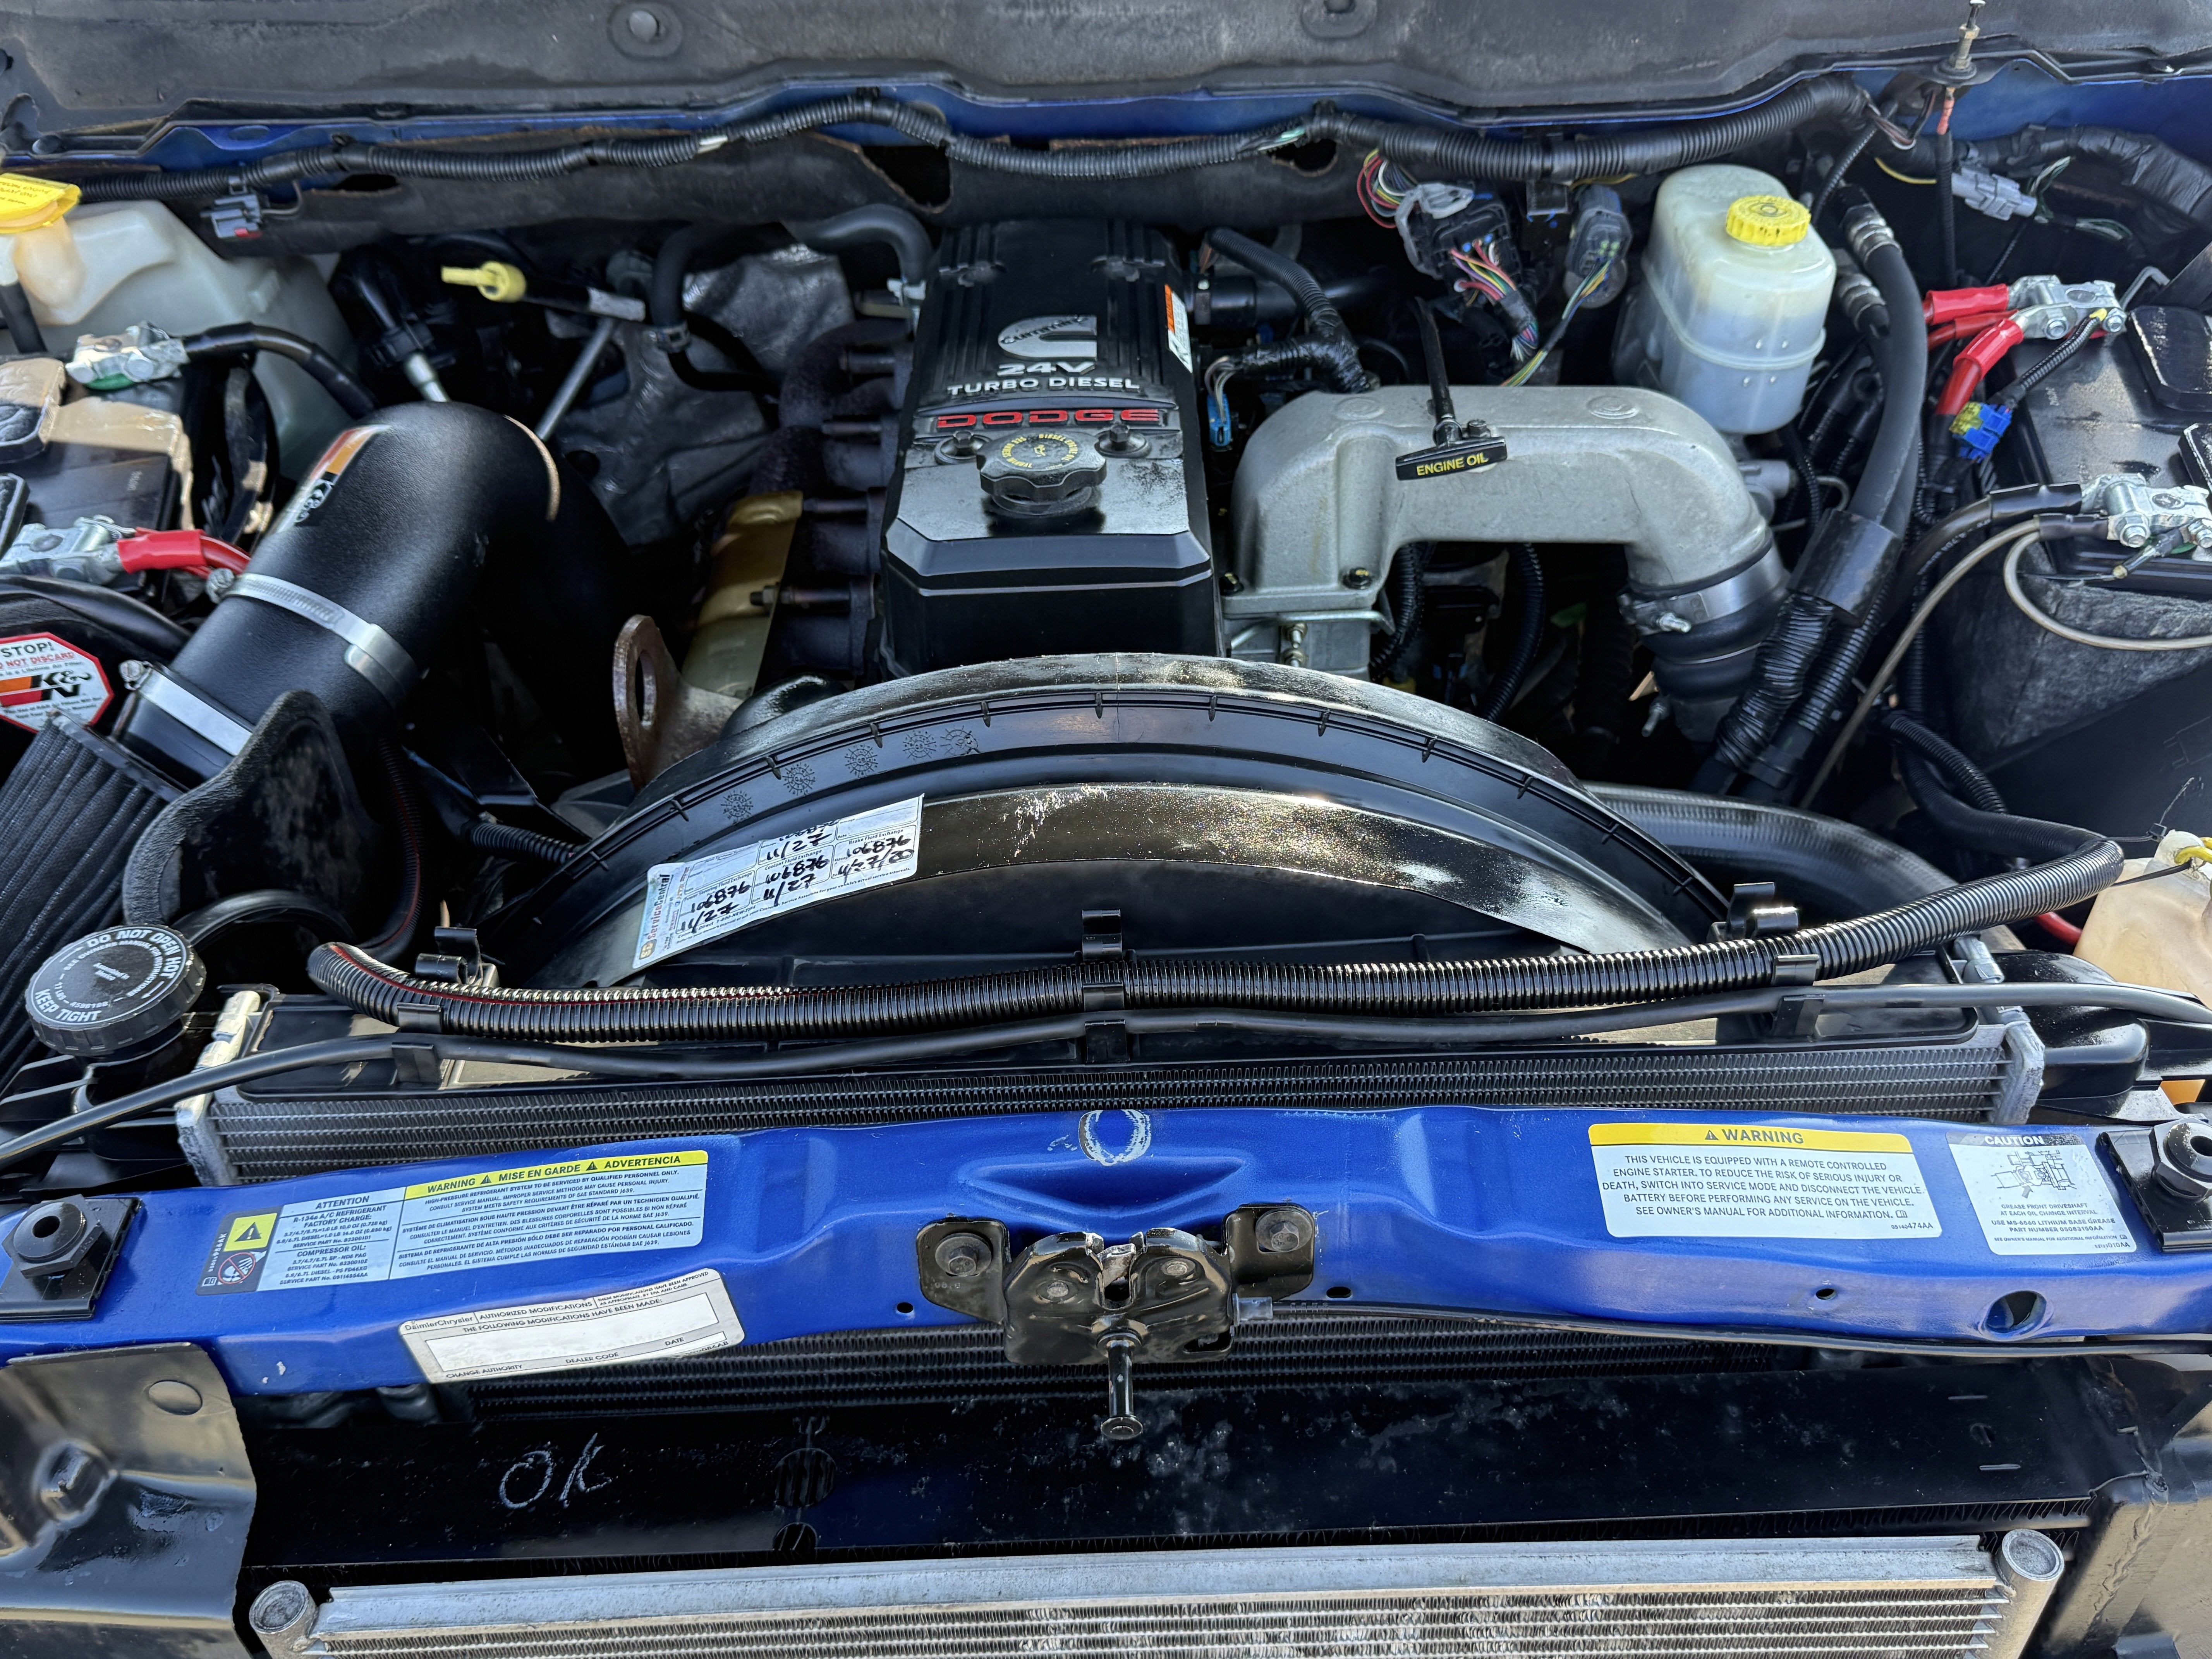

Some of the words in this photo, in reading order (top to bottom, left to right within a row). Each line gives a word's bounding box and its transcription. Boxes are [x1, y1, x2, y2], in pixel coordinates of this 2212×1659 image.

[997, 362, 1096, 376] 24V
[948, 378, 1039, 395] TURBO
[1049, 377, 1140, 391] DIESEL
[938, 409, 1159, 428] DODGE
[1416, 457, 1465, 476] ENGINE
[1467, 452, 1489, 466] OIL
[0, 642, 55, 658] STOP!
[6, 659, 26, 667] NOT
[31, 652, 75, 664] DISCARD
[847, 835, 912, 857] 106876
[691, 881, 751, 913] 106876
[86, 934, 111, 948] DO
[116, 929, 152, 940] NOT
[149, 933, 181, 956] OPEN
[160, 956, 182, 979] HOT
[35, 988, 60, 1013] KEEP
[55, 1008, 102, 1022] TIGHT
[1721, 1129, 1804, 1144] WARNING
[1984, 1135, 2046, 1145] CAUTION
[604, 1156, 681, 1169] ADVERTENCIA
[1624, 1155, 1648, 1163] THIS
[1649, 1155, 1691, 1164] VEHICLE
[1692, 1156, 1702, 1164] IS
[1704, 1156, 1751, 1165] EQUIPPED
[1753, 1158, 1778, 1166] WITH
[1788, 1159, 1826, 1169] REMOTE
[1827, 1161, 1887, 1170] CONTROLLED
[498, 1171, 525, 1182] MISE
[527, 1169, 542, 1178] EN
[544, 1164, 581, 1176] GARDE
[1613, 1168, 1651, 1177] ENGINE
[1653, 1168, 1698, 1177] STARTER.
[1698, 1168, 1712, 1177] TO
[1714, 1169, 1753, 1178] REDUCE
[1754, 1170, 1774, 1178] THE
[1775, 1170, 1797, 1180] RISK
[1798, 1171, 1810, 1180] OF
[1813, 1172, 1852, 1182] SERIOUS
[1854, 1174, 1885, 1183] INJURY
[428, 1178, 476, 1193] WARNING
[470, 1187, 509, 1197] REFRIGERANT
[1602, 1181, 1638, 1191] DEATH,
[1640, 1180, 1678, 1190] SWITCH
[1681, 1181, 1704, 1190] INTO
[1706, 1182, 1747, 1190] SERVICE
[1748, 1182, 1777, 1191] MODE
[1779, 1183, 1799, 1192] AND
[1801, 1184, 1859, 1194] DISCONNECT
[315, 1195, 369, 1210] ATTENTION
[524, 1194, 567, 1204] REQUIREMENTS
[1623, 1193, 1665, 1202] BATTERY
[1668, 1194, 1707, 1202] BEFORE
[1708, 1194, 1771, 1204] PERFORMING
[1774, 1195, 1791, 1204] ANY
[1794, 1196, 1833, 1206] SERVICE
[1834, 1198, 1849, 1206] ON
[1870, 1198, 1914, 1206] VEHICLE.
[335, 1205, 387, 1217] REFRIGERANT
[1636, 1206, 1655, 1215] SEE
[1657, 1206, 1701, 1216] OWNER'S
[1703, 1207, 1745, 1216] MANUAL
[1747, 1207, 1766, 1216] FOR
[1769, 1208, 1824, 1218] ADDITIONAL
[1825, 1210, 1893, 1219] INFORMATION.
[304, 1218, 338, 1228] FACTORY
[339, 1214, 372, 1223] CHARGE:
[297, 1246, 350, 1257] COMPRESSOR
[478, 1320, 526, 1331] FOLLOWING
[527, 1313, 590, 1324] MODIFICATIONS
[591, 1308, 613, 1316] HAVE
[614, 1304, 635, 1312] BEEN
[636, 1298, 663, 1308] MADE:
[480, 1310, 527, 1320] AUTHORIZED
[529, 1302, 592, 1314] MODIFICATIONS
[404, 1317, 472, 1331] DaimlerChrysler
[665, 1337, 684, 1346] DATE
[595, 1352, 619, 1360] CODE
[446, 1369, 481, 1378] CHANGE
[482, 1364, 522, 1374] AUTHORITY
[498, 1432, 612, 1509] OK
